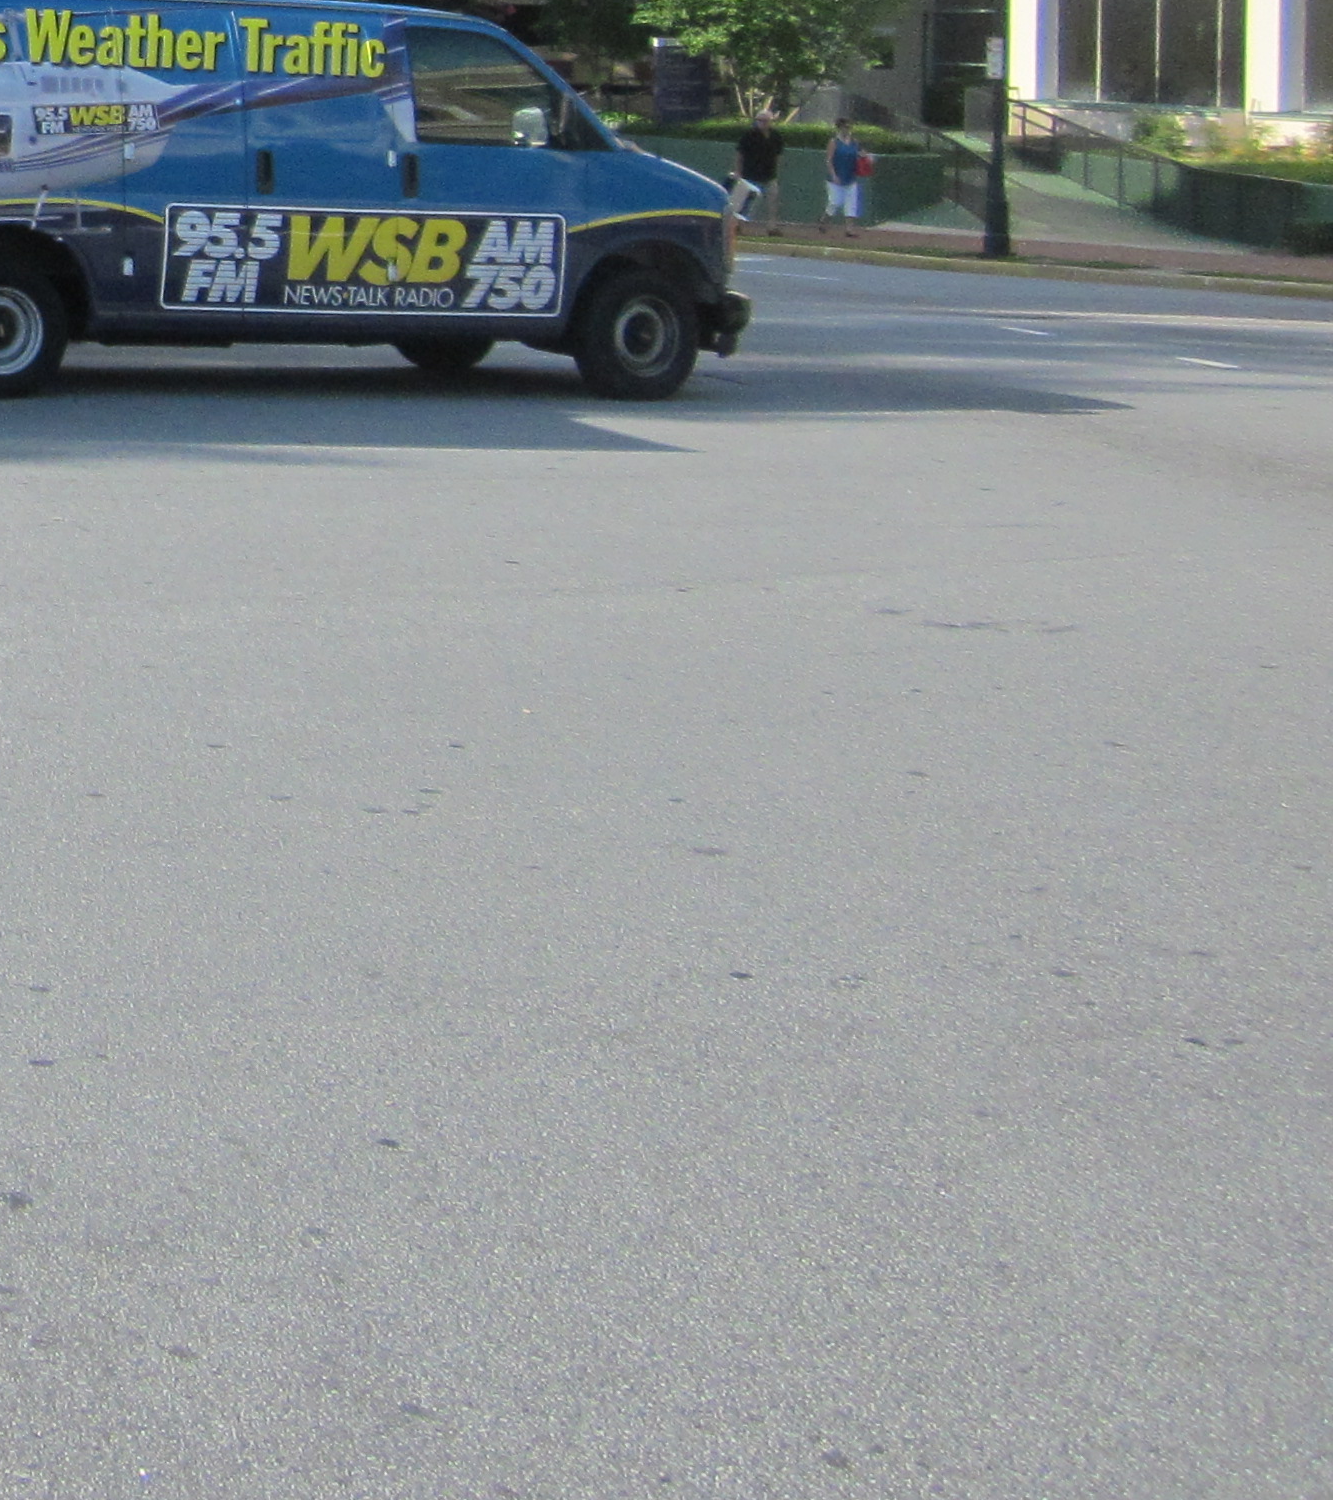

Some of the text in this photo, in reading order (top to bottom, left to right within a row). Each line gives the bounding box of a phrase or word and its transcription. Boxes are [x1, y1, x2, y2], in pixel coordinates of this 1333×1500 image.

[25, 7, 226, 71] Weather
[239, 16, 386, 79] Traffic
[41, 121, 65, 134] FM
[69, 105, 126, 126] WSB
[129, 104, 153, 118] AM
[173, 210, 556, 286] 95.5 WSB AM
[181, 258, 557, 310] FM 750
[393, 288, 455, 309] RADIO
